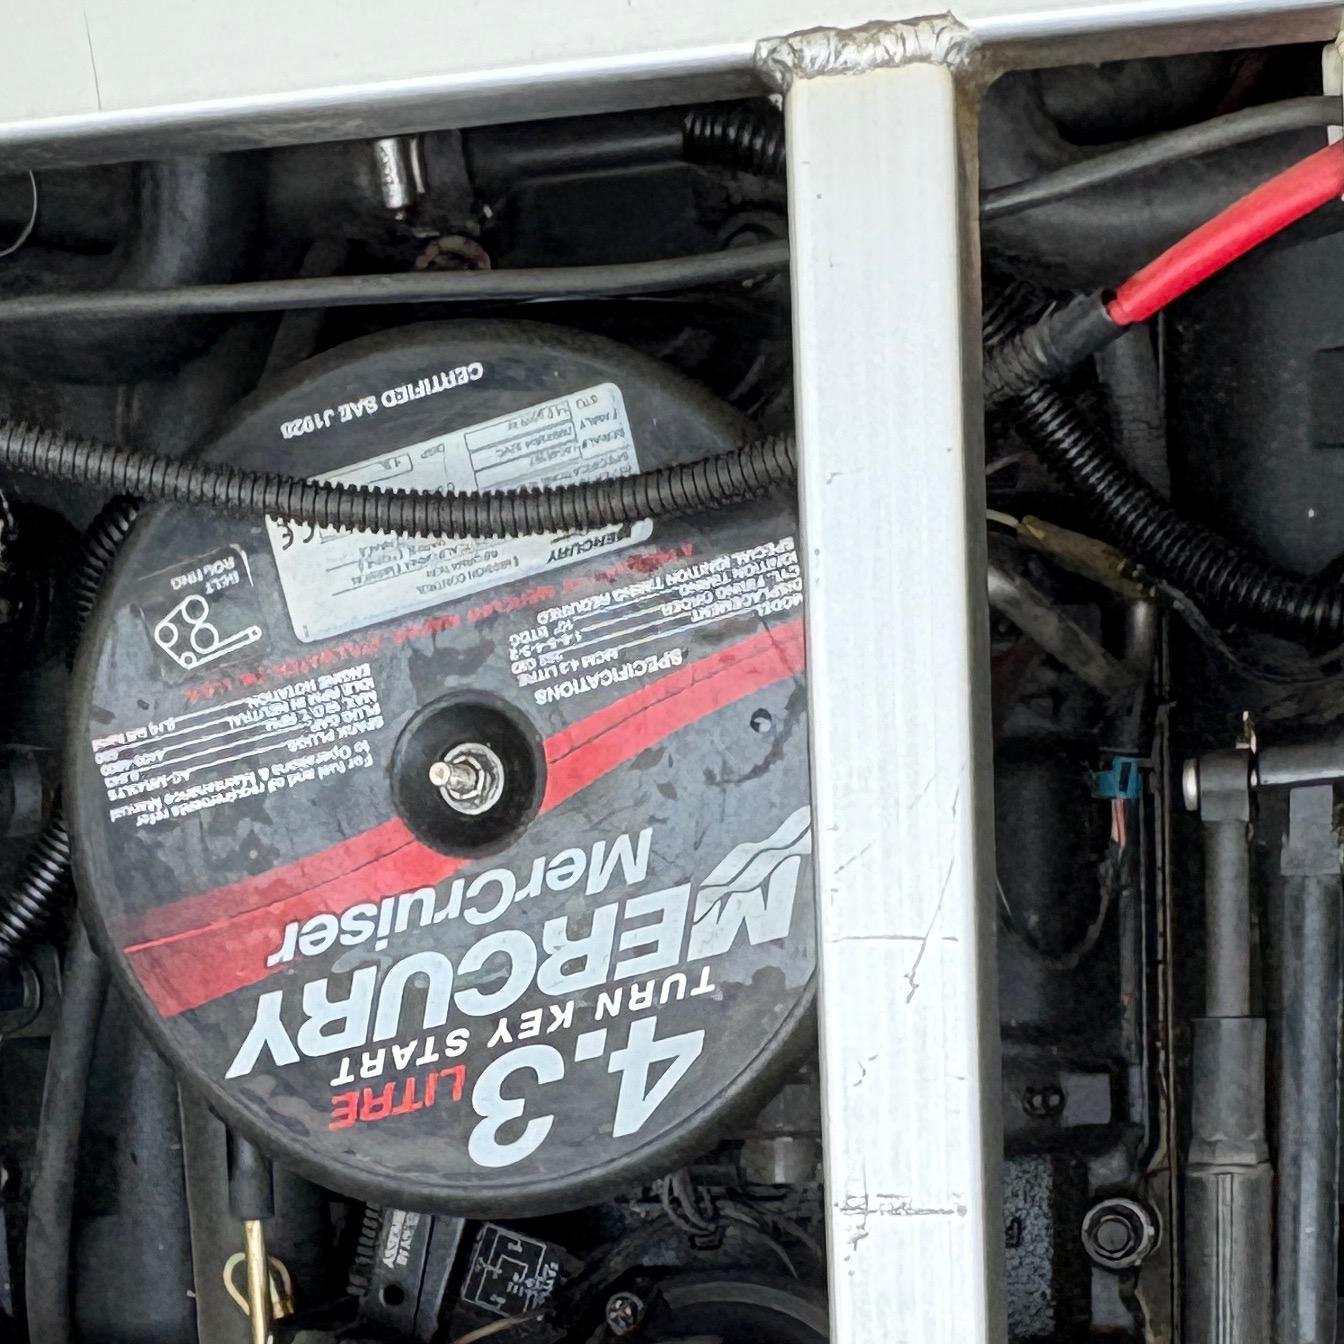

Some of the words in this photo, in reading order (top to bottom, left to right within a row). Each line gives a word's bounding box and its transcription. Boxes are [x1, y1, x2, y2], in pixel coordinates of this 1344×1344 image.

[336, 394, 379, 422] SAE
[378, 360, 485, 409] CERTIFIED
[531, 647, 684, 706] SPECIFICATIONS
[346, 752, 373, 770] For
[267, 828, 654, 968] MerCruiser
[225, 853, 802, 1080] MERCURY
[594, 968, 716, 1021] TURN
[486, 1000, 575, 1049] KEY
[330, 1030, 470, 1086] START
[328, 1064, 466, 1131] LITRE
[468, 1015, 706, 1169] 4.3
